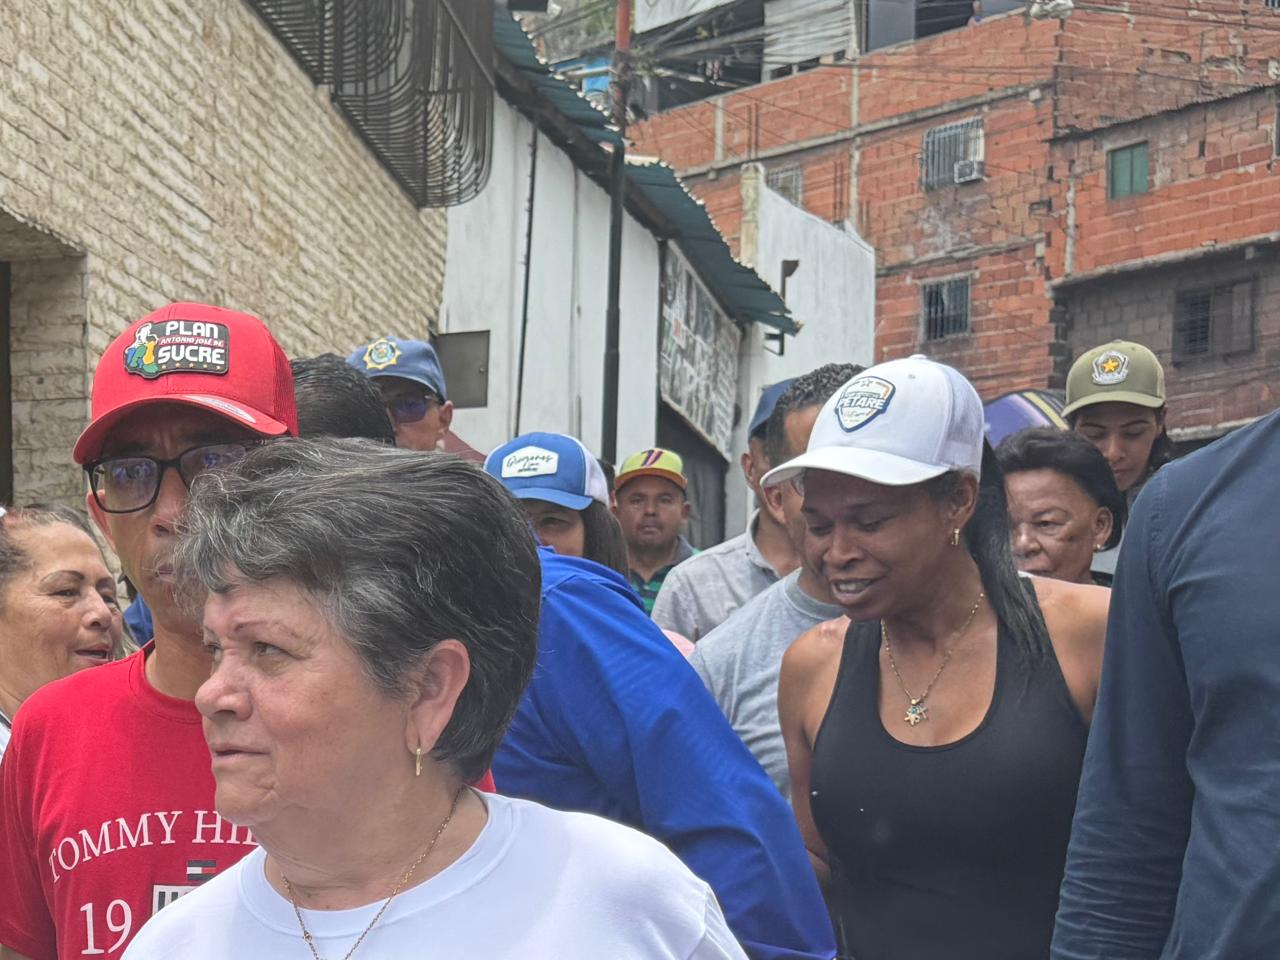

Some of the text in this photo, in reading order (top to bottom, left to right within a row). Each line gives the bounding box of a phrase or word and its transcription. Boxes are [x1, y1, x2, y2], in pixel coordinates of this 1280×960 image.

[166, 321, 218, 338] PLAN
[160, 336, 194, 345] ANTONIO
[157, 345, 225, 364] SUCRE
[837, 398, 885, 410] PETARE
[48, 810, 183, 883] TOMMY
